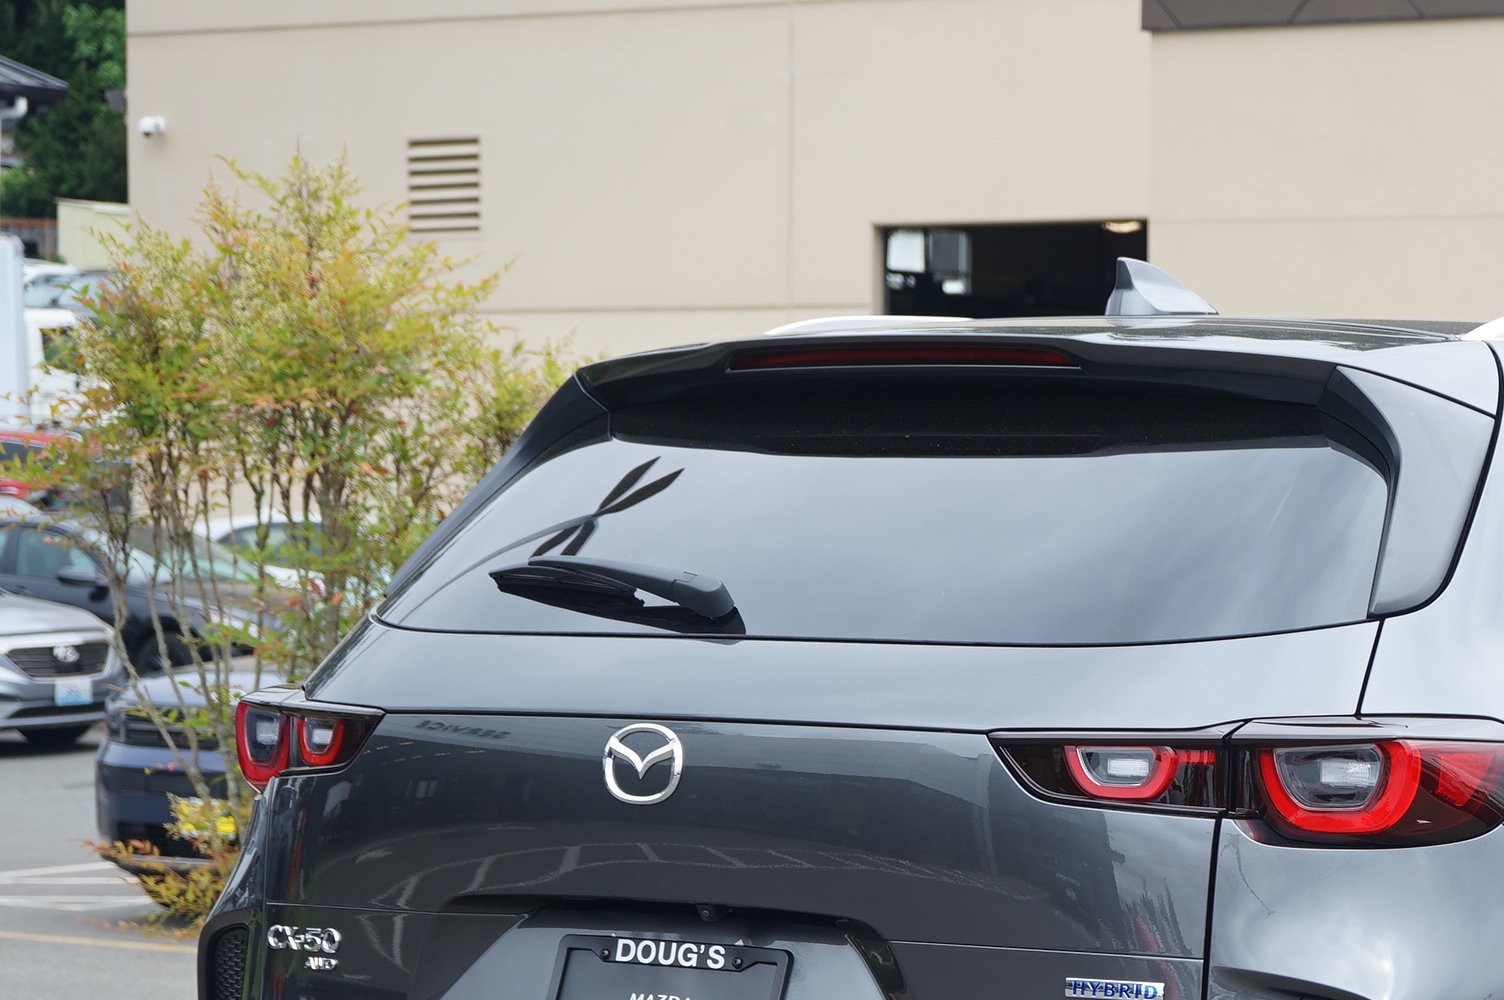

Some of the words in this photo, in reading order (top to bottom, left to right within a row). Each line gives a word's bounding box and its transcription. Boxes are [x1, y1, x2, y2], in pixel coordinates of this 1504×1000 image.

[266, 924, 342, 954] CX-50
[303, 956, 339, 970] AWD
[615, 938, 726, 969] DOUG'S
[1072, 980, 1158, 1000] HYBRID
